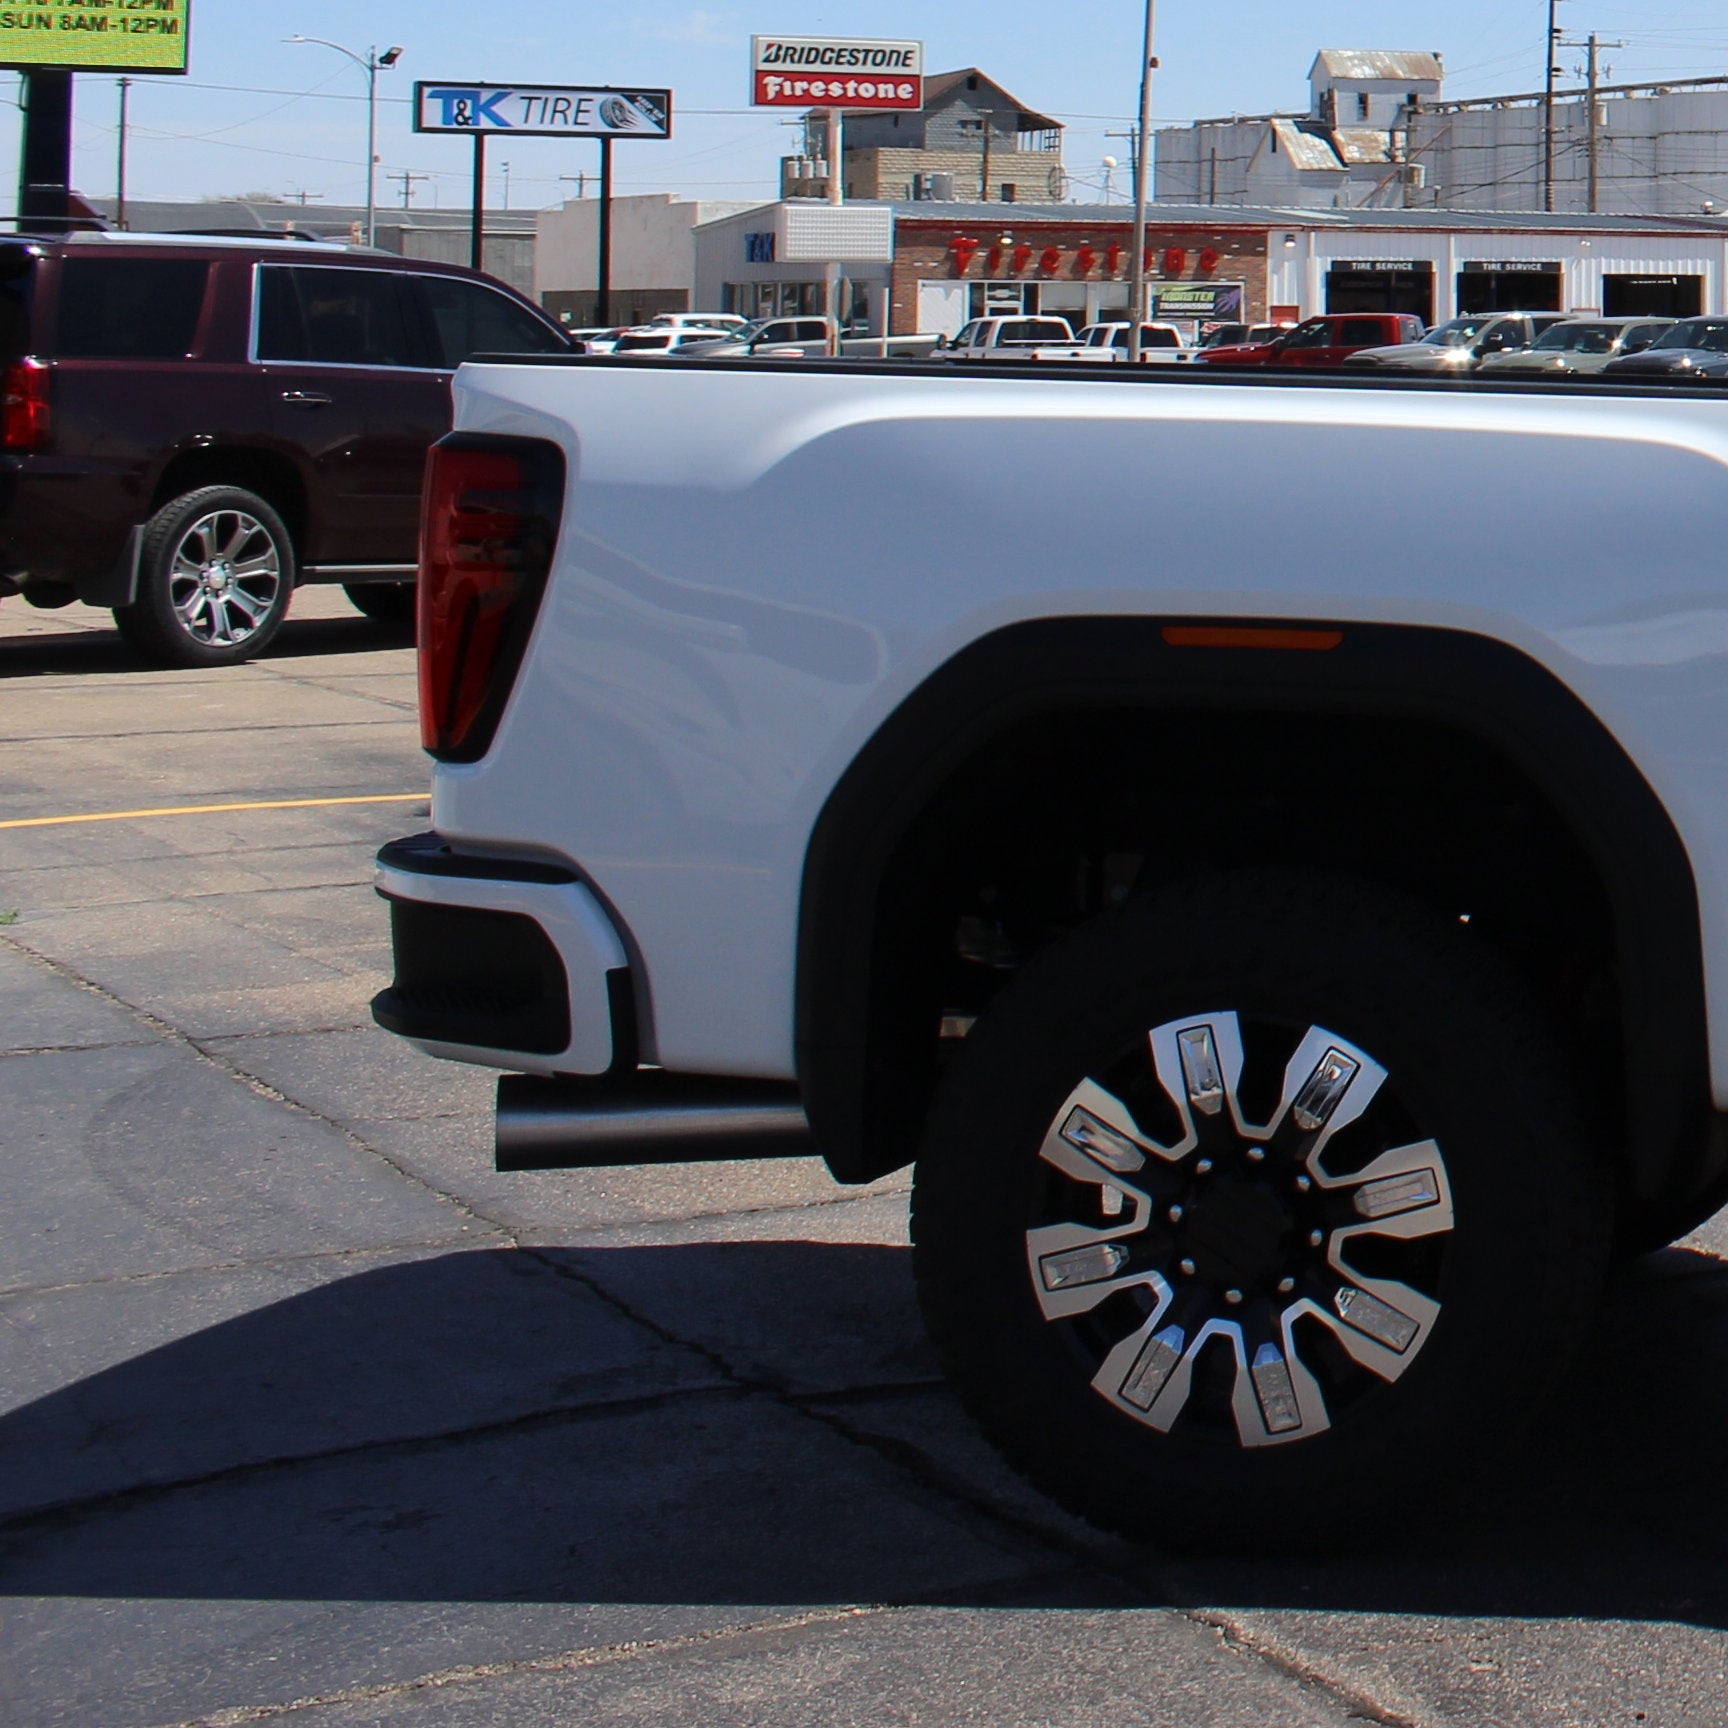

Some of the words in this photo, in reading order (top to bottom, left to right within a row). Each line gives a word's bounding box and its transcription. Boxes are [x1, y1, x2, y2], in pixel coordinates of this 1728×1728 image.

[60, 13, 179, 35] 8AM-12PM
[762, 43, 915, 68] BRIDGESTONE
[762, 75, 914, 101] Firestone
[426, 89, 514, 128] T&K
[518, 95, 595, 126] TIRE
[1351, 262, 1372, 271] TIRE
[1375, 262, 1414, 271] SERVICE
[1482, 262, 1502, 271] TIRE
[1505, 263, 1543, 271] SERVICE
